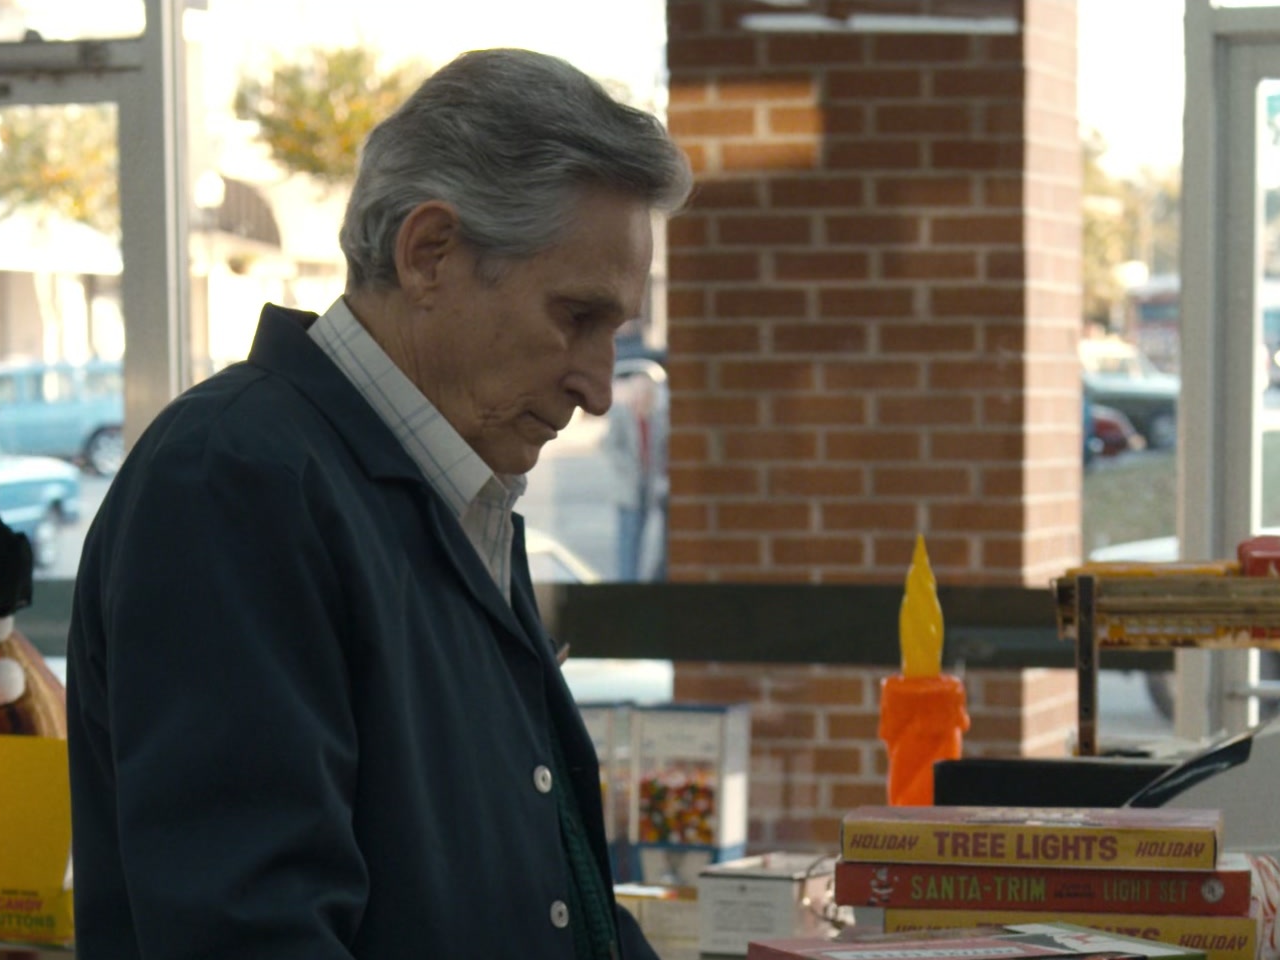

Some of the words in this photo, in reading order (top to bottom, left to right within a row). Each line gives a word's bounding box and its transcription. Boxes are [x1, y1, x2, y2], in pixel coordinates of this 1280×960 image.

[850, 833, 920, 851] HOLIDAY
[933, 831, 1007, 858] TREE
[1016, 833, 1119, 862] LIGHTS
[1135, 841, 1206, 858] HOLIDAY
[910, 874, 1046, 901] SANTA-TRIM
[1103, 879, 1152, 902] LIGHT
[1158, 880, 1190, 904] SET
[1178, 932, 1249, 951] HOLIDAY
